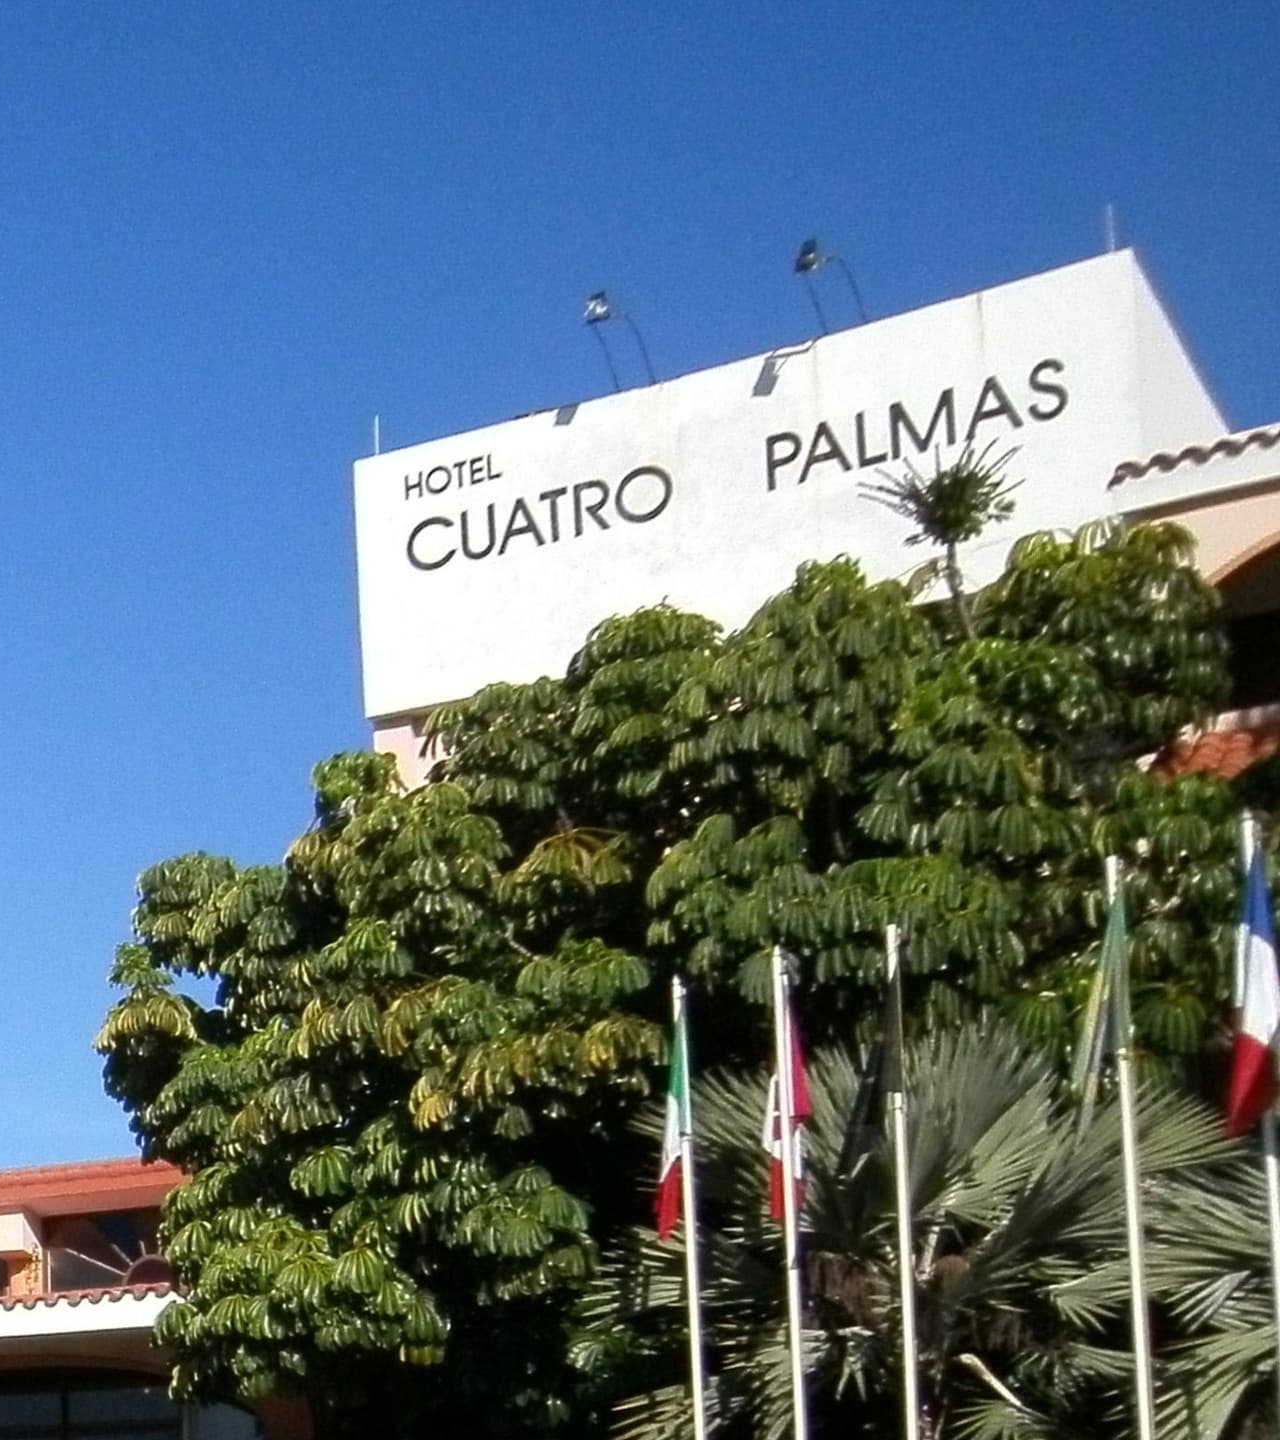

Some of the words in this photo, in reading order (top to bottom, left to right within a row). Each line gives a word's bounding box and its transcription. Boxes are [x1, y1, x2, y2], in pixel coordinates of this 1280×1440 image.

[404, 453, 503, 501] HOTEL
[406, 465, 674, 571] CUATRO
[765, 358, 1069, 492] PALMAS
